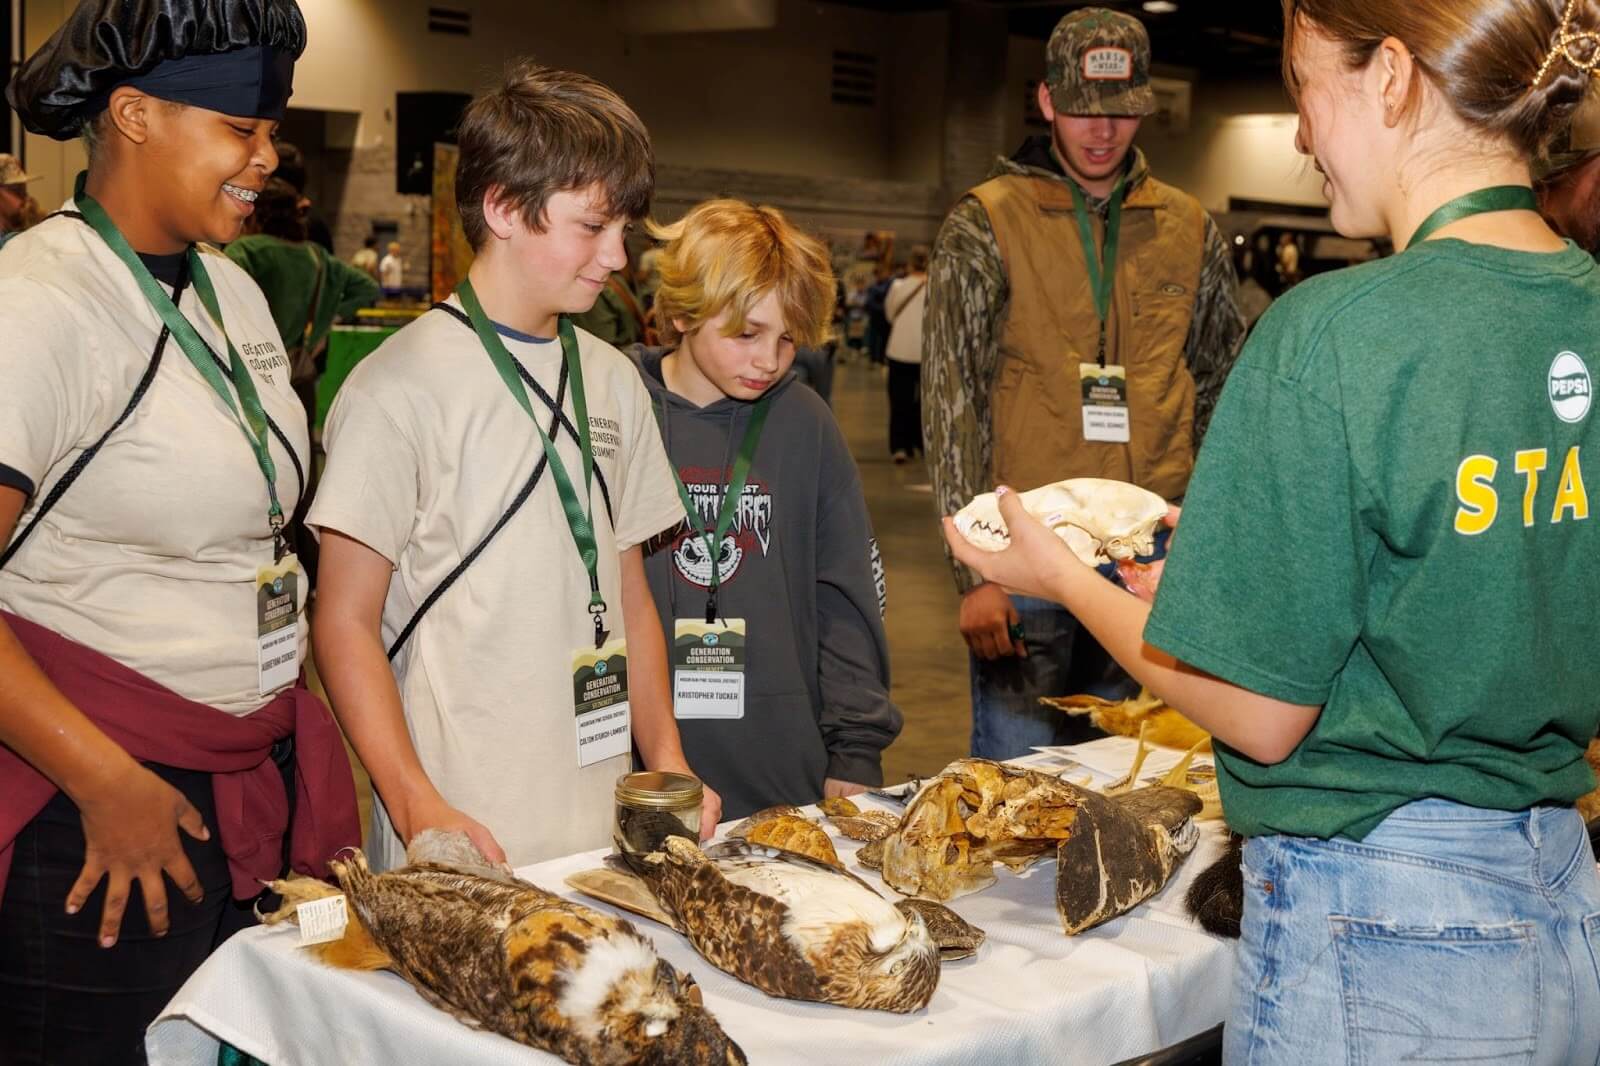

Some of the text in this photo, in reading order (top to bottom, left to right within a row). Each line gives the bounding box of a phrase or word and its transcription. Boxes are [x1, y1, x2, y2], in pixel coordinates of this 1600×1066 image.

[1091, 52, 1125, 63] MARSH
[1551, 379, 1589, 396] PEPSI
[589, 416, 620, 433] ENERATION
[687, 483, 717, 494] YOUR
[1454, 446, 1589, 536] STA
[690, 647, 731, 656] GENERATION
[686, 655, 735, 664] CONSERVATION
[586, 674, 617, 691] GENERATION
[583, 683, 621, 702] CONSERVATION
[678, 691, 738, 700] KRISTOPHER TUCKER
